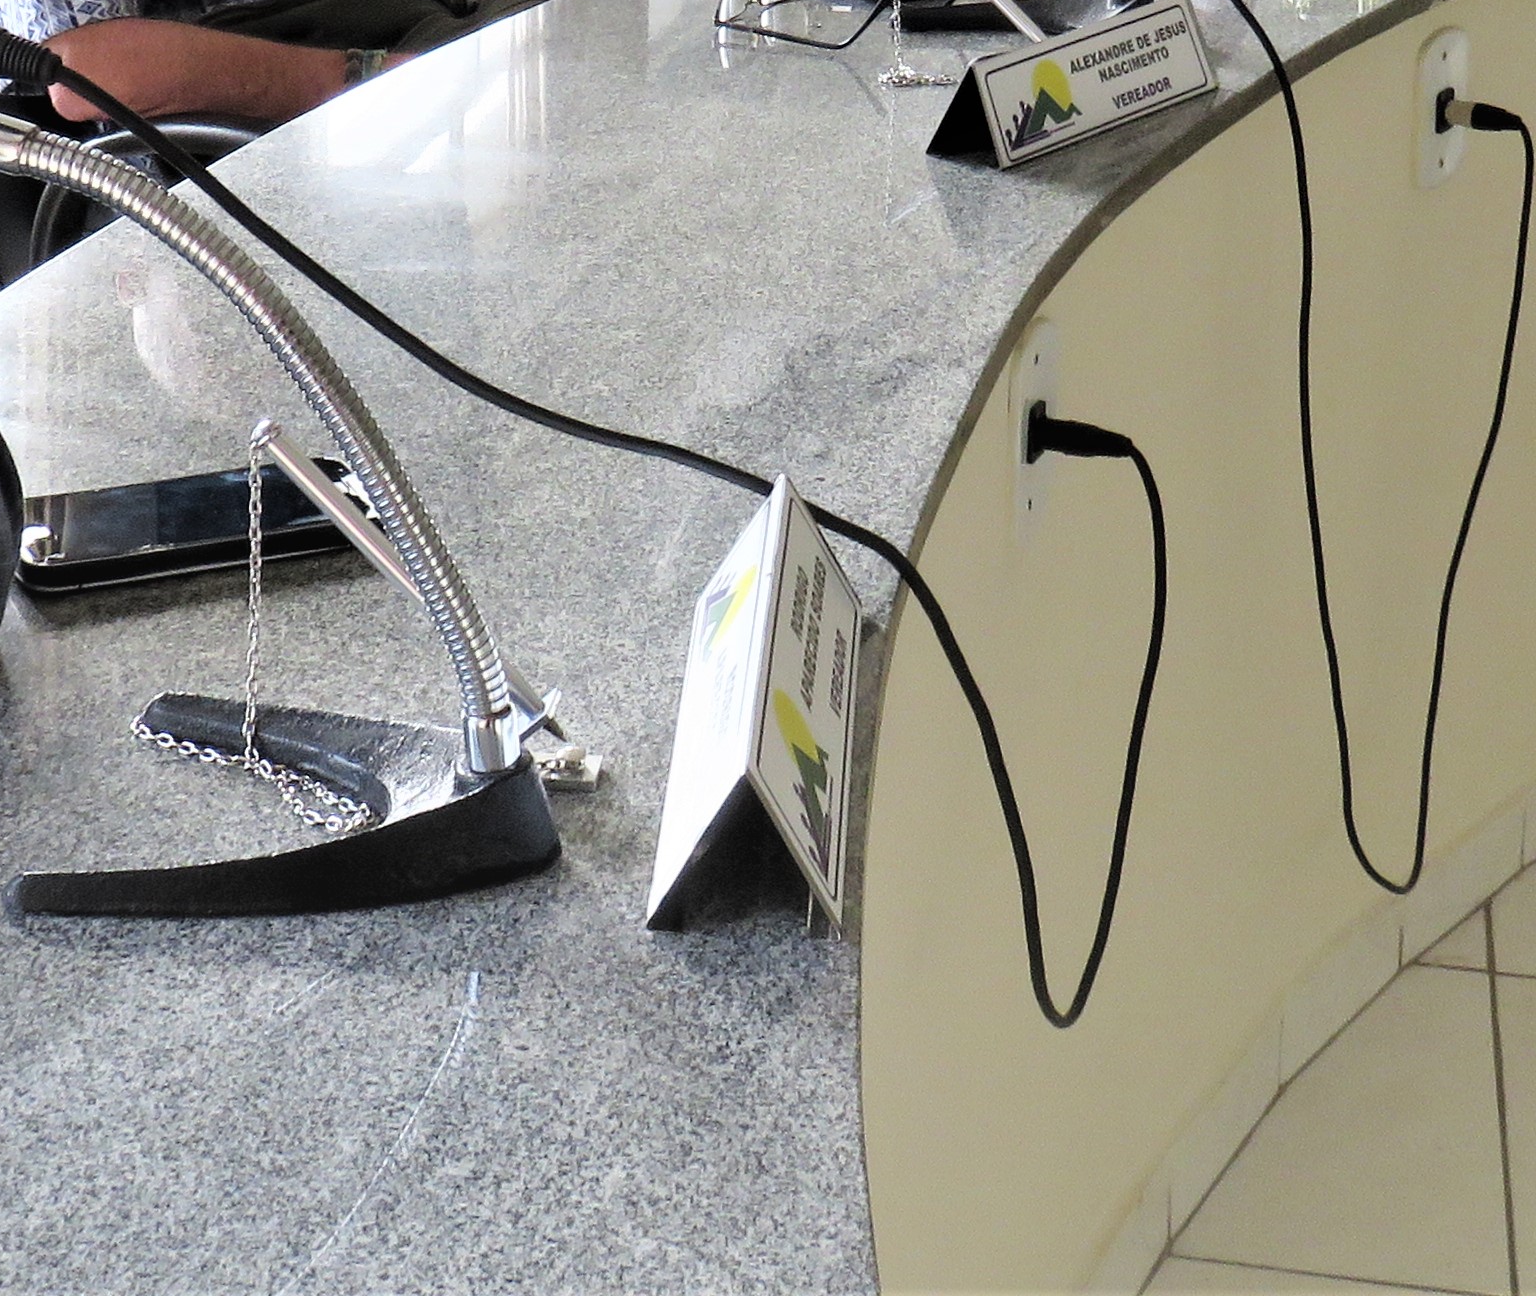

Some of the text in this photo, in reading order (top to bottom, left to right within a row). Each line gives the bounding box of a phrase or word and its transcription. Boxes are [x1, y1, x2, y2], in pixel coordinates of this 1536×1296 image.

[1069, 21, 1187, 74] ALEXANDRE DE JESUS
[1098, 46, 1169, 83] NASCIMENTO
[1112, 76, 1172, 110] VEREADOR
[790, 565, 809, 643] RODRIGO
[800, 555, 826, 714] APARECIDO SOARES
[829, 628, 847, 719] VEREADOR
